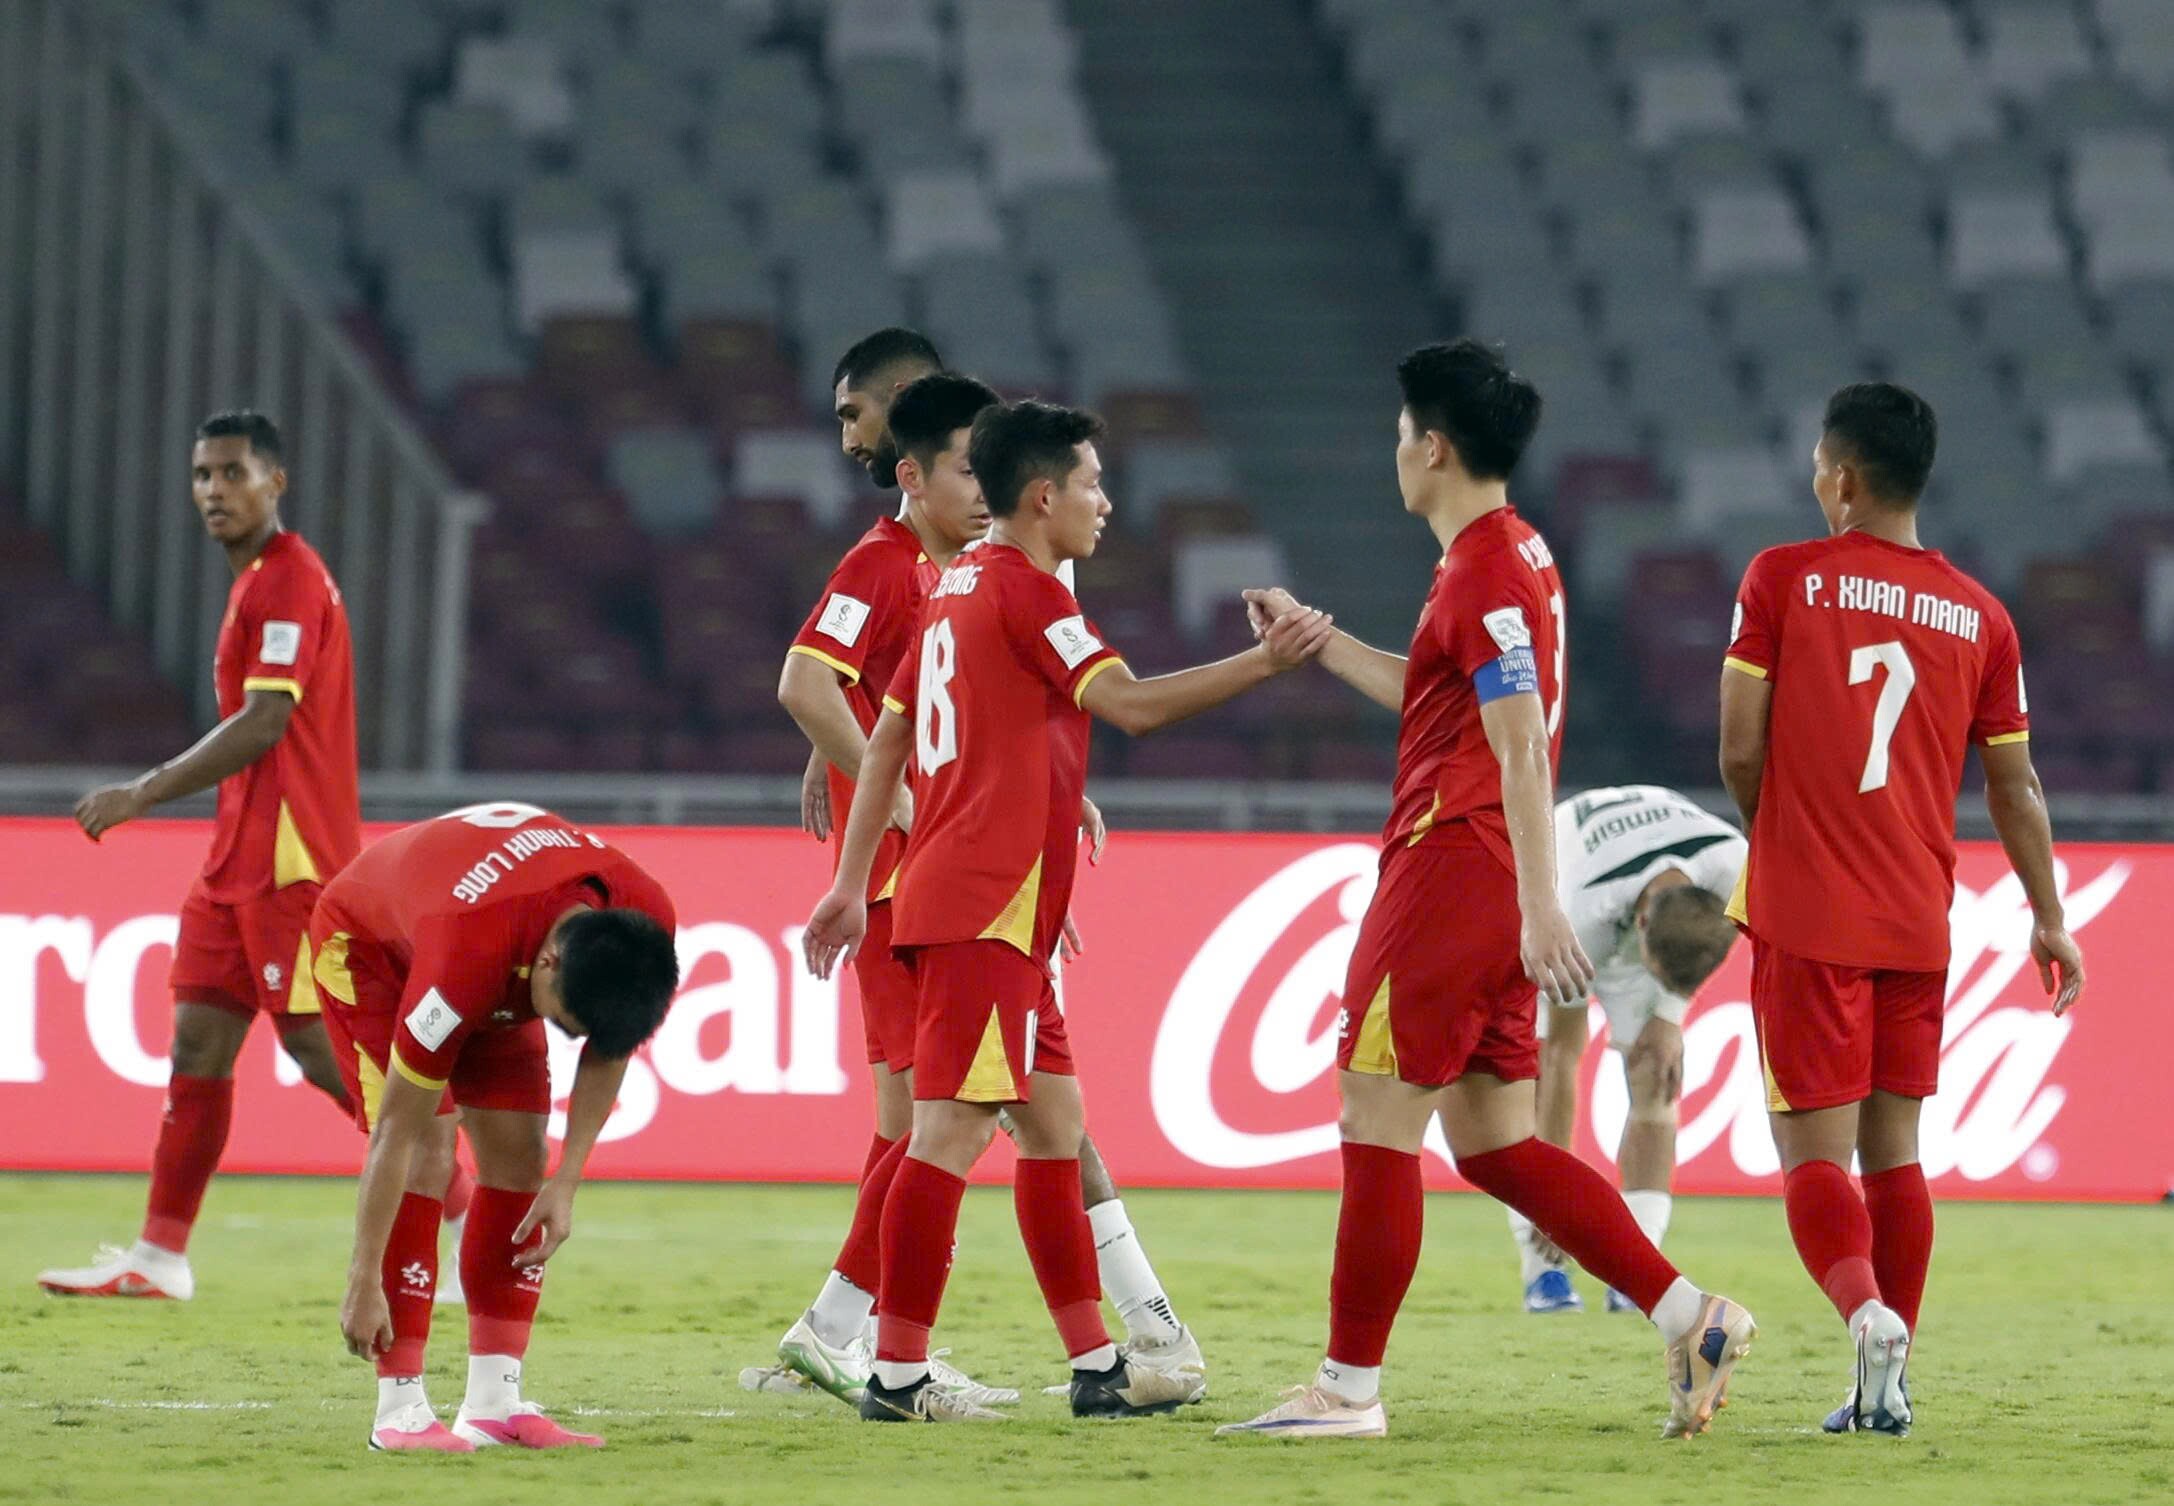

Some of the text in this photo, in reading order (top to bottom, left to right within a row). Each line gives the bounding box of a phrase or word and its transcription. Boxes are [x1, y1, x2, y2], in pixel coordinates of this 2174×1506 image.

[1805, 574, 1980, 643] P. XUAN MANH
[1848, 640, 1916, 794] 7
[503, 827, 580, 861] THANH
[452, 852, 514, 904] LONG
